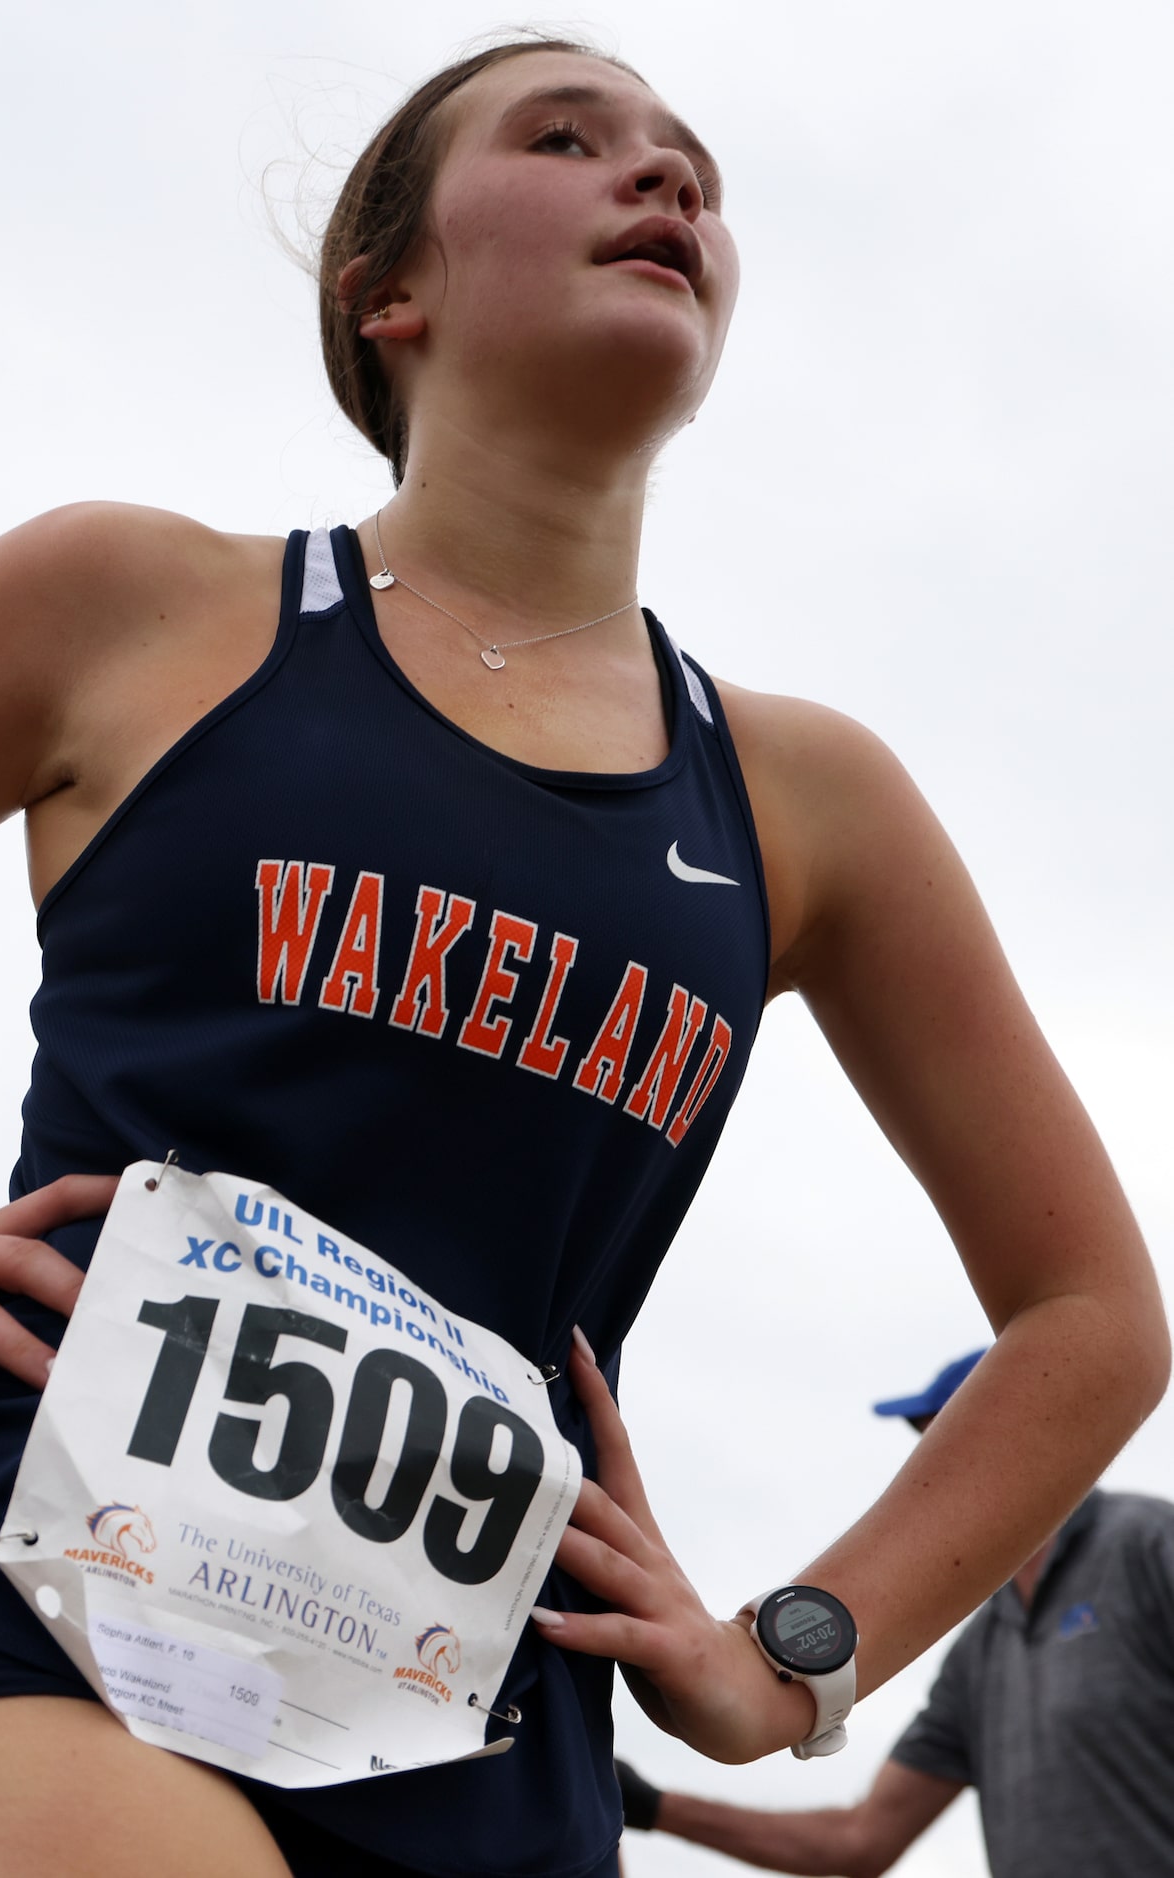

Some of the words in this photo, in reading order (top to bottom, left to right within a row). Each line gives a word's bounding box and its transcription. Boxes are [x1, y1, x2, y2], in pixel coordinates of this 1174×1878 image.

[254, 858, 734, 1150] WAKELAND
[234, 1193, 303, 1245] UIL
[316, 1233, 437, 1323] Region
[443, 1317, 465, 1348] II
[178, 1236, 243, 1272] XC
[254, 1245, 511, 1405] Championship
[127, 1295, 545, 1585] 1509
[63, 1548, 155, 1585] MAVERICKS
[84, 1565, 137, 1588] ARLINGTON
[179, 1522, 218, 1554] The
[227, 1538, 327, 1596] University
[332, 1583, 354, 1603] of
[357, 1589, 402, 1627] Texas
[188, 1561, 378, 1654] ARLINGTON
[97, 1623, 132, 1643] Sophia
[183, 1649, 195, 1661] 10
[119, 1668, 172, 1693] Wakeland
[229, 1684, 260, 1706] 1509
[393, 1667, 454, 1703] MAVERICKS
[406, 1683, 441, 1706] ARLINGTON
[138, 1693, 156, 1707] XC
